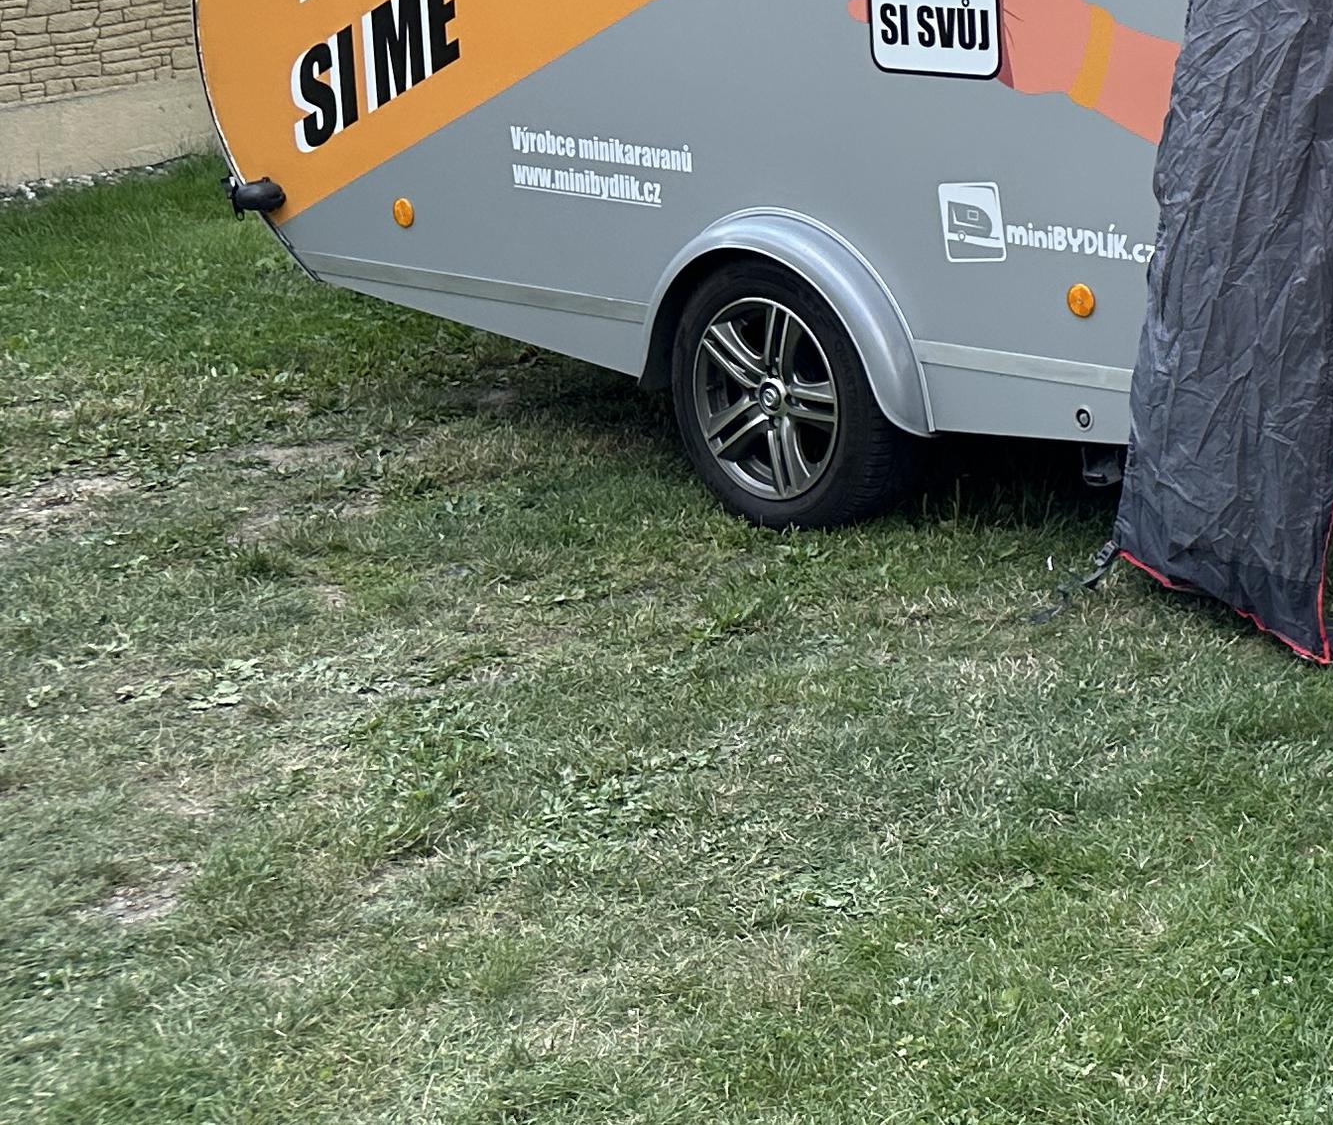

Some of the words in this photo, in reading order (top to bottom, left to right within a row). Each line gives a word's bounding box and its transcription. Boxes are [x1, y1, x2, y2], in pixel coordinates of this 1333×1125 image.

[879, 3, 910, 46] SI
[292, 24, 358, 152] SI
[510, 125, 576, 158] Výrobce
[578, 136, 693, 173] minikaravanů
[512, 163, 662, 205] www.minibydlik.cz
